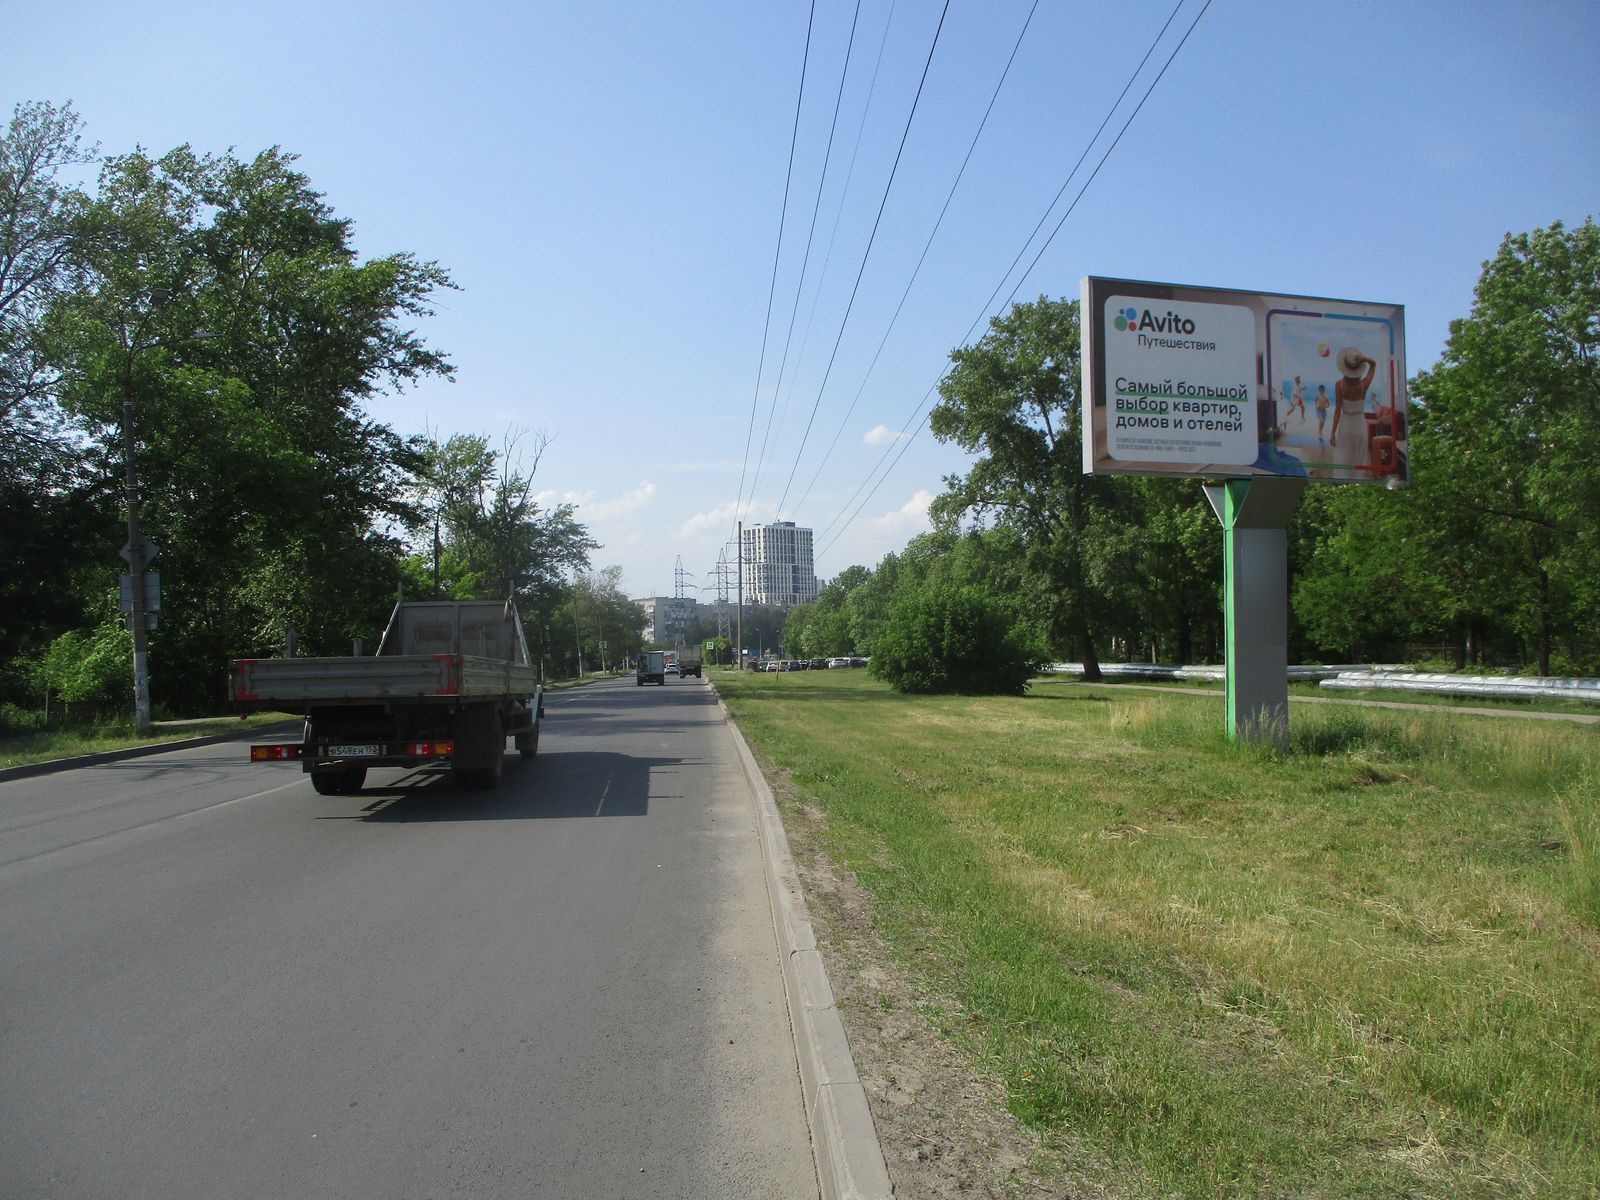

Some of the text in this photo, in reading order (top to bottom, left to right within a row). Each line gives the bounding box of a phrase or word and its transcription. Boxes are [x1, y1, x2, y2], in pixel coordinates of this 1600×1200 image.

[1138, 309, 1196, 334] Avito
[1138, 334, 1216, 351] Путешествия
[1115, 377, 1247, 399] Самый большой
[1116, 396, 1242, 418] выбор квартир,
[1116, 415, 1243, 432] домов и отелей
